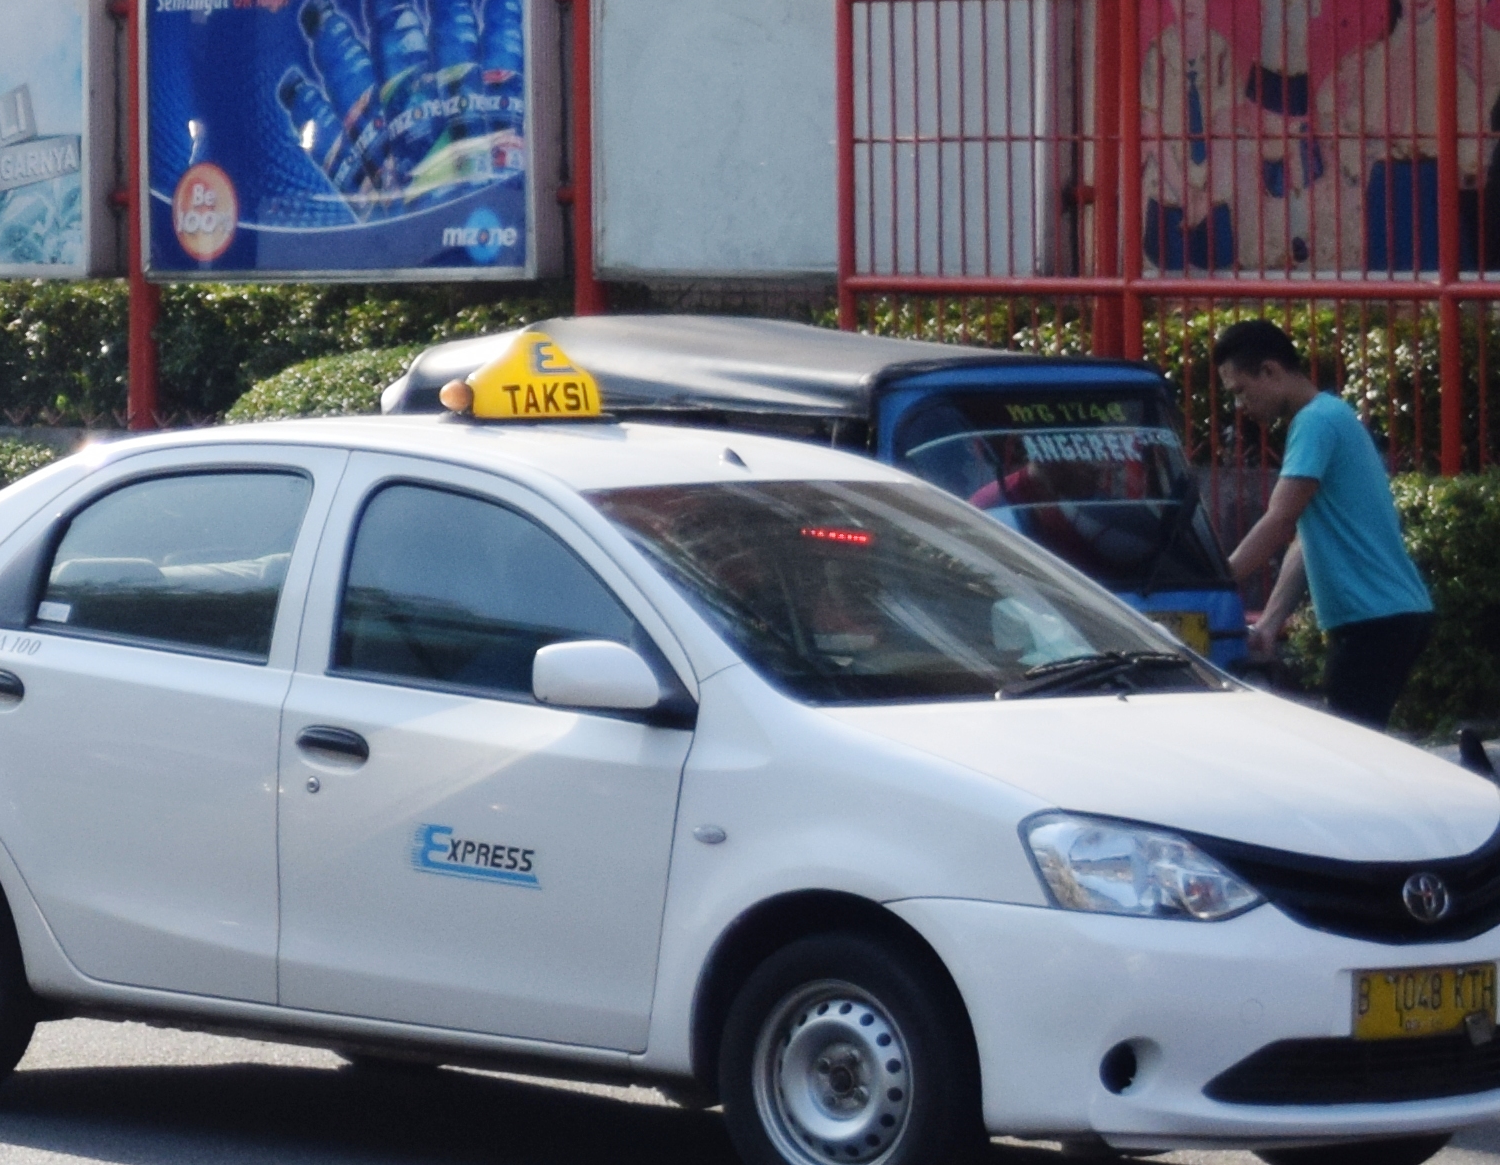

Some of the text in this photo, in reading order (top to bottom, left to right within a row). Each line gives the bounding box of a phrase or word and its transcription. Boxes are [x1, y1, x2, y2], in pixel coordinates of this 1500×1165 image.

[193, 183, 216, 206] Be
[442, 226, 518, 247] mizone
[502, 382, 590, 414] TAKSI
[1023, 434, 1143, 463] ANGGREK
[8, 636, 42, 656] 100
[1358, 977, 1370, 1015] B
